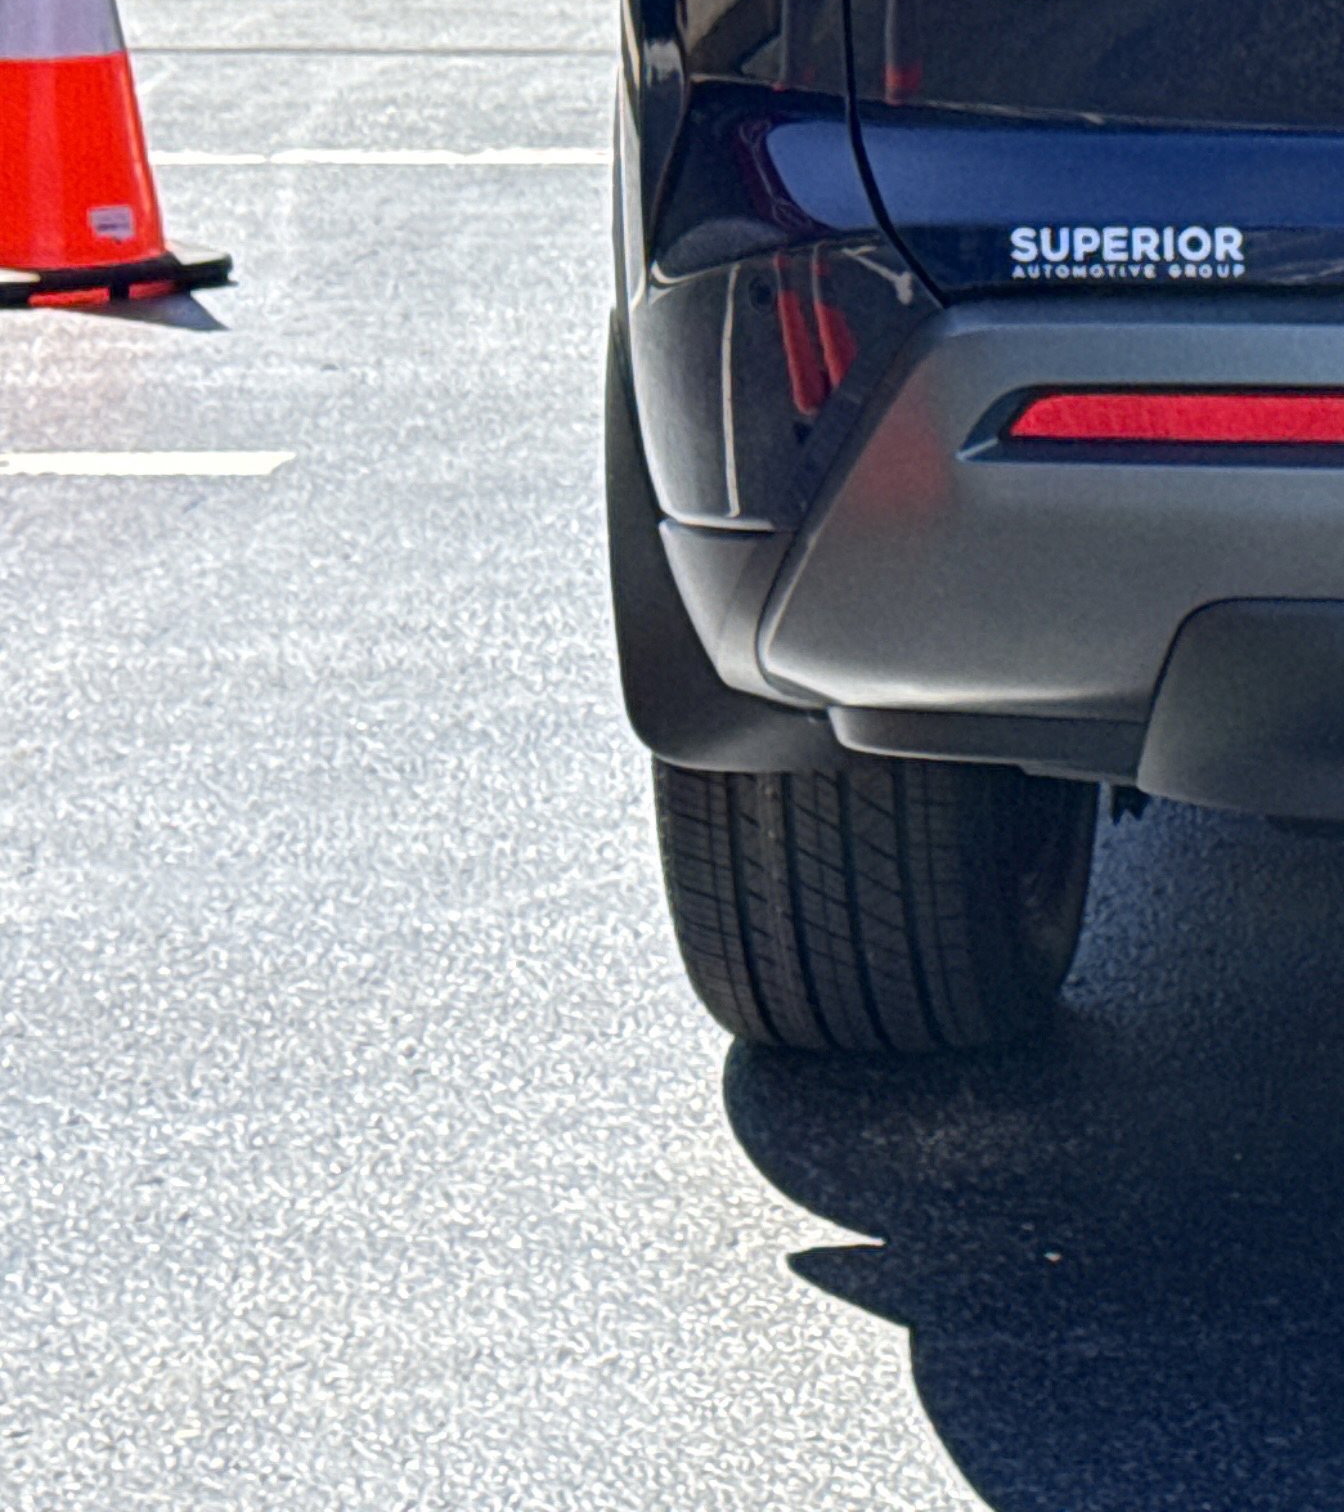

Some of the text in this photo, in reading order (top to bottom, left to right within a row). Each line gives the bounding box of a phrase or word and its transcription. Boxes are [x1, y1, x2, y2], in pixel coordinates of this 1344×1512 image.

[1010, 226, 1245, 263] SUPERIOR
[1011, 263, 1246, 279] AUTOMOTIVE GROUP
